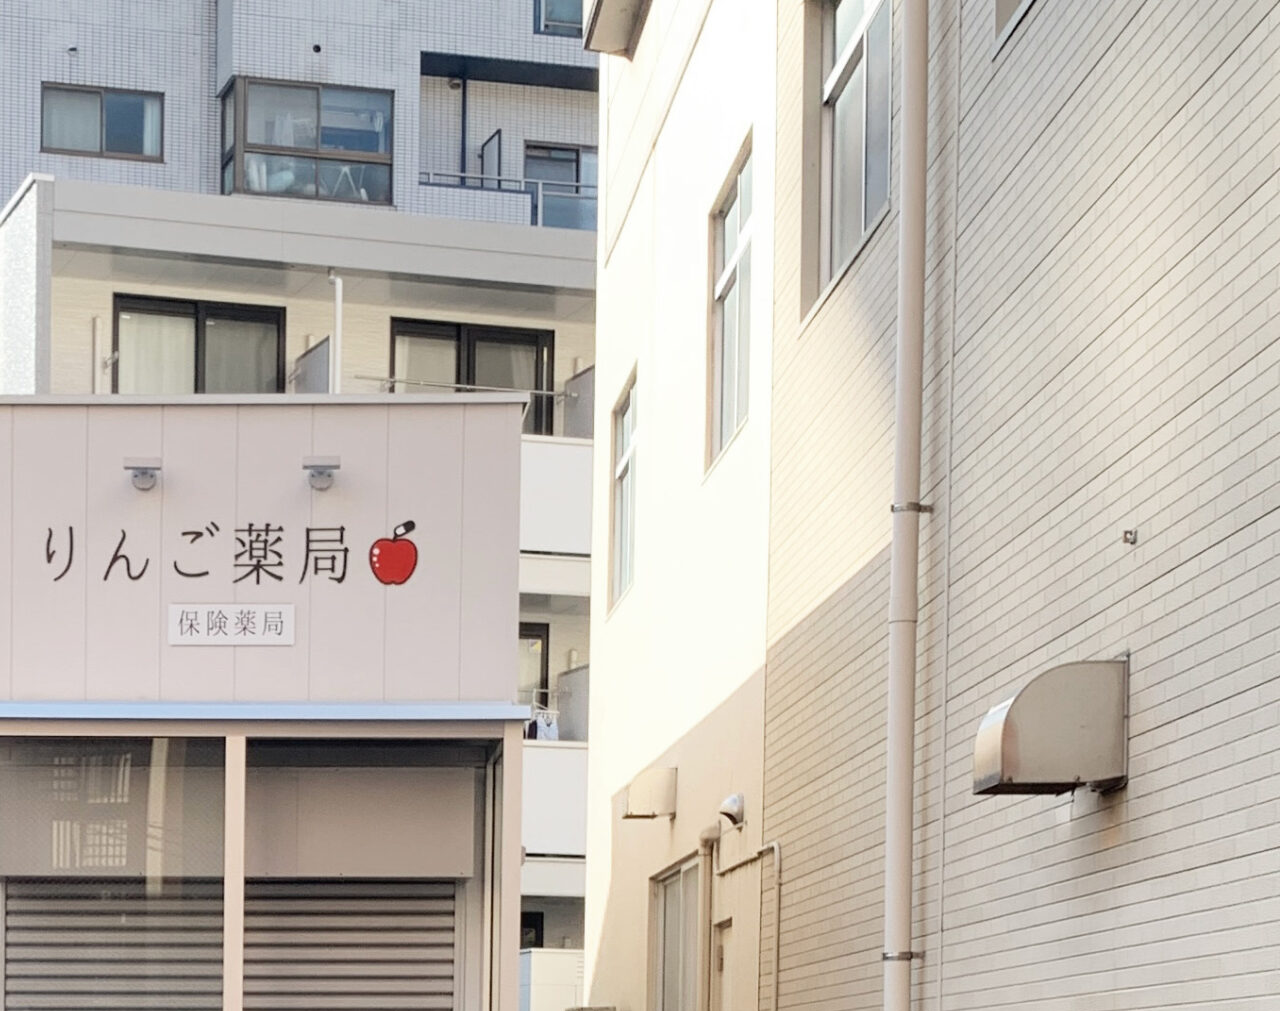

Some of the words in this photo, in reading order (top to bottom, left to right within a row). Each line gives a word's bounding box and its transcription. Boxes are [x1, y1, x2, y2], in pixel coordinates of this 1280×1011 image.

[45, 521, 350, 585] りんご薬局
[177, 609, 285, 637] 保険薬局
